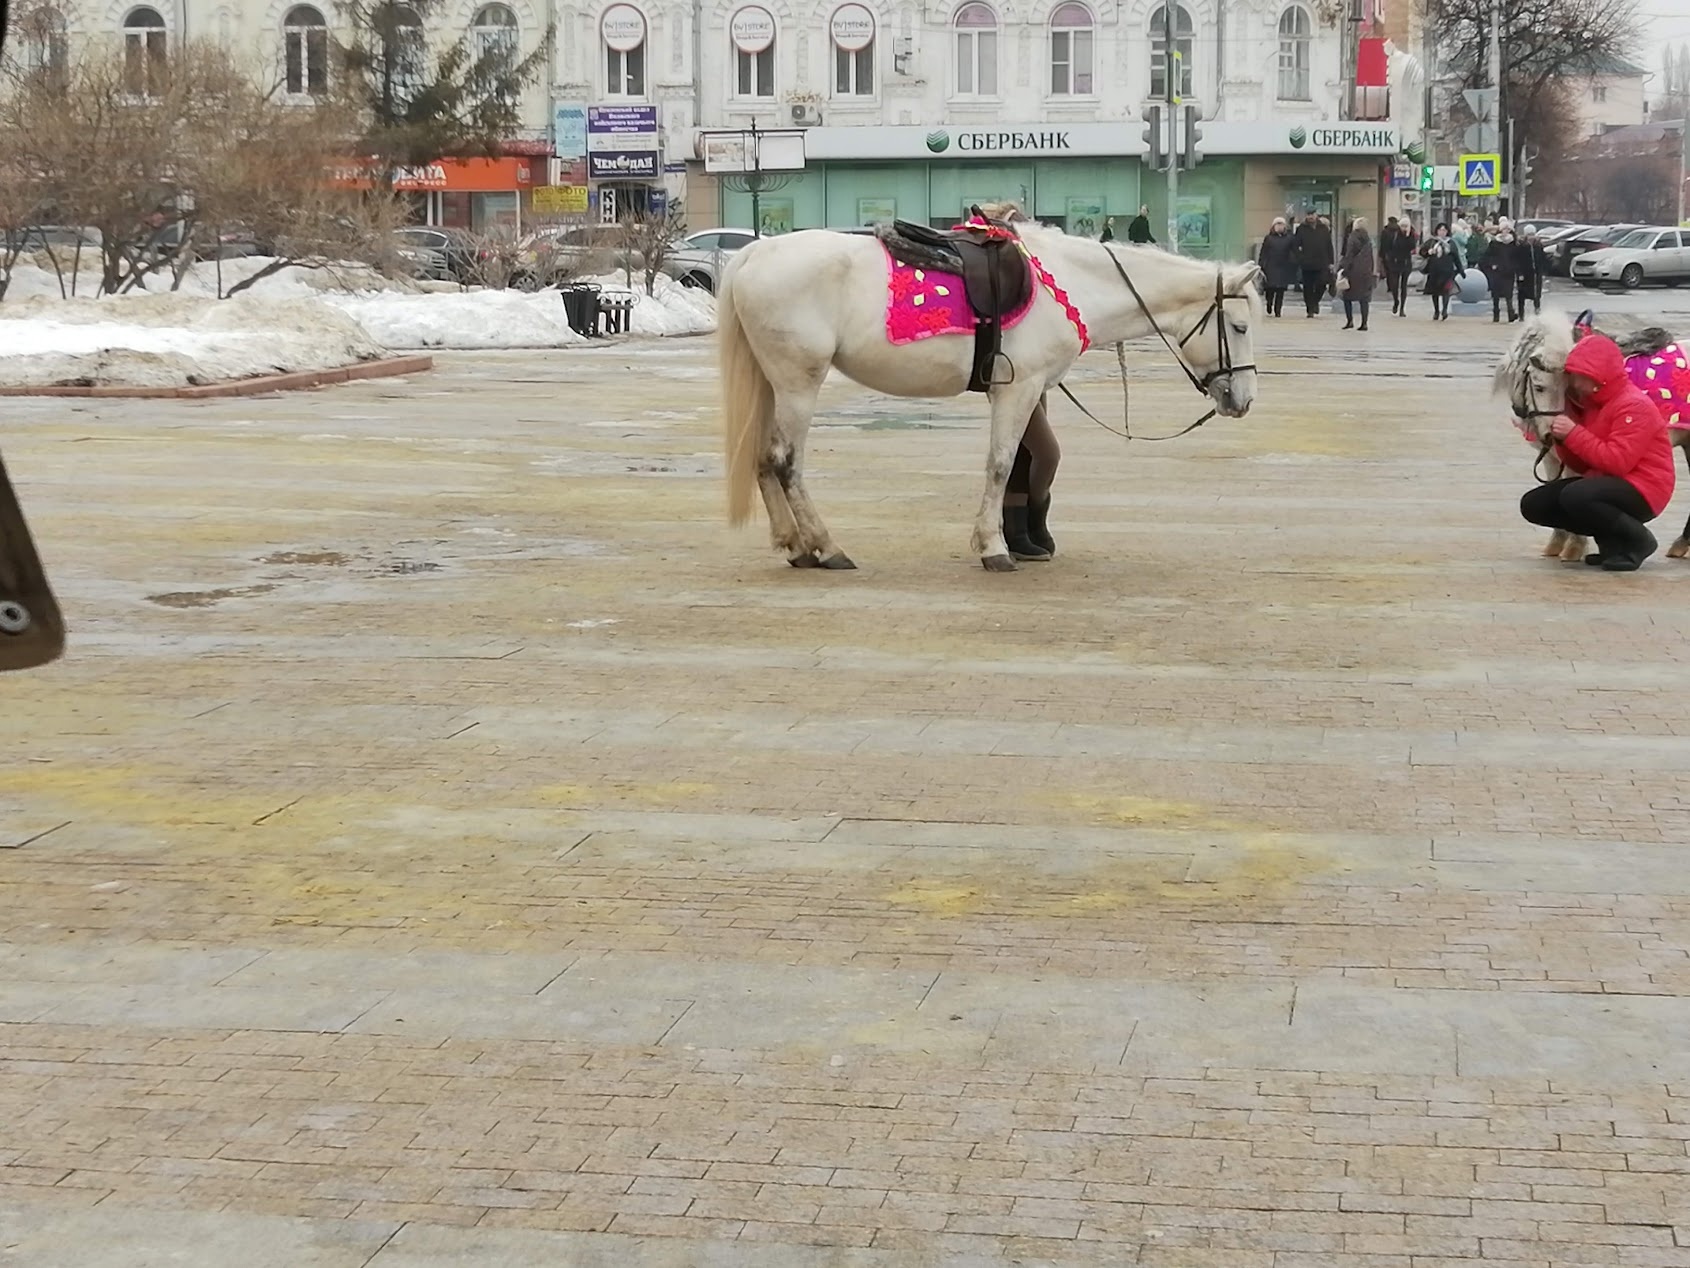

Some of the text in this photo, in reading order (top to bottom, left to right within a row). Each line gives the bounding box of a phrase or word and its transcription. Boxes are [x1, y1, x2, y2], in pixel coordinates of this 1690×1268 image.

[958, 132, 1070, 151] СБЕРБАНК
[1312, 129, 1394, 147] СБЕРБАНК
[593, 156, 654, 170] ЧЕМОДАН
